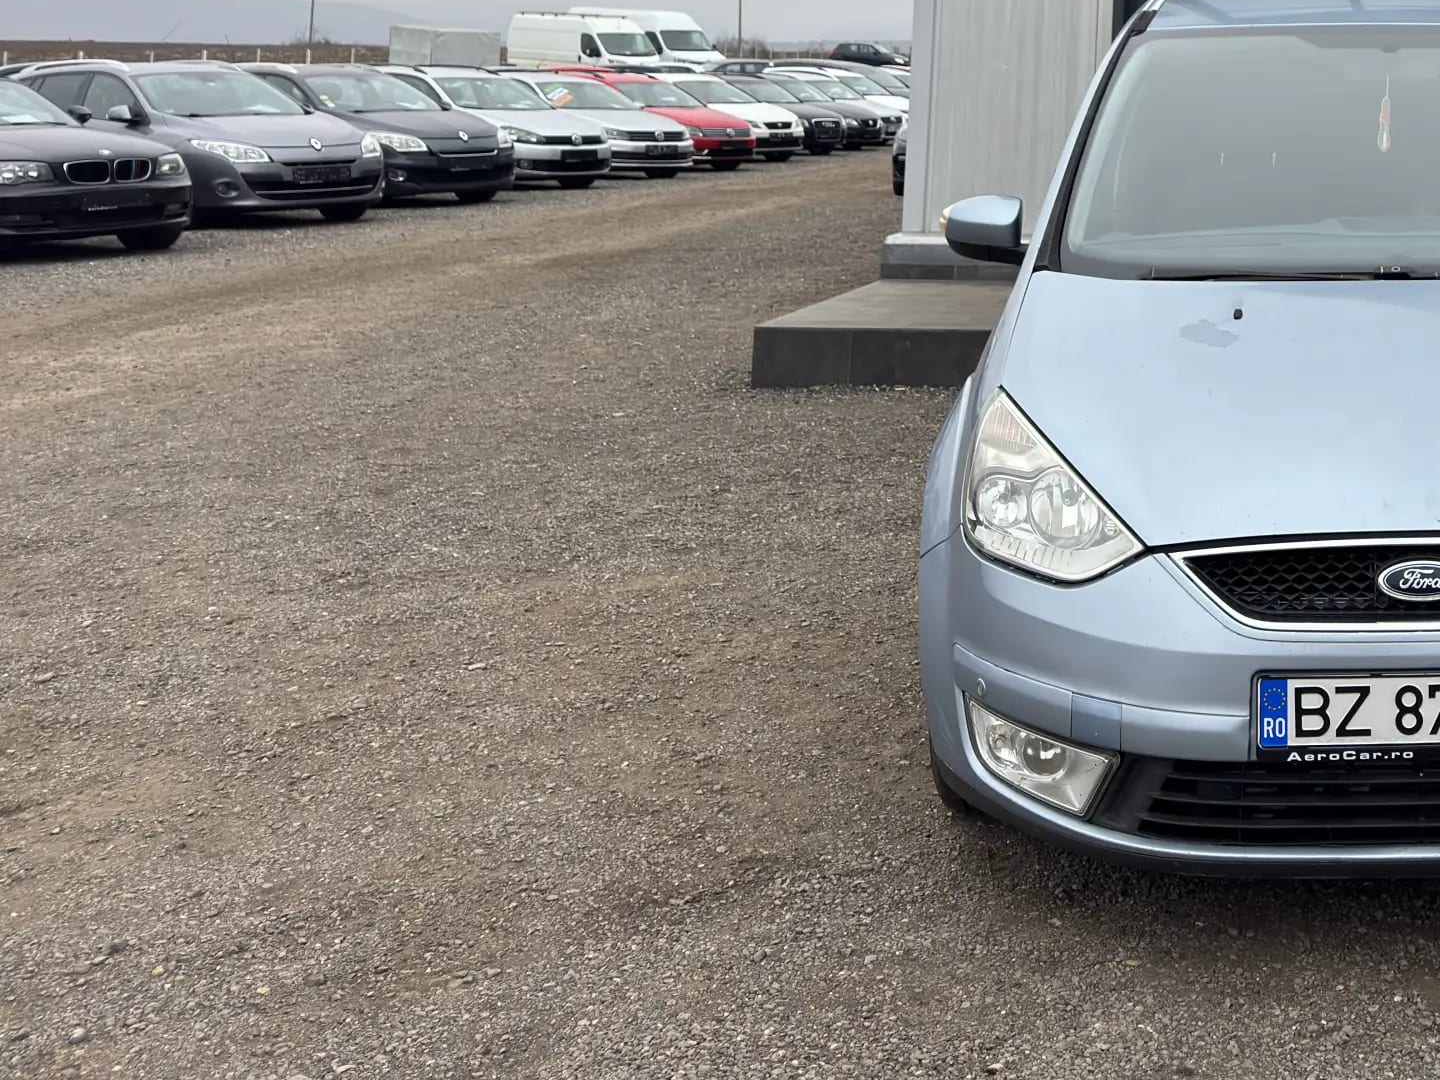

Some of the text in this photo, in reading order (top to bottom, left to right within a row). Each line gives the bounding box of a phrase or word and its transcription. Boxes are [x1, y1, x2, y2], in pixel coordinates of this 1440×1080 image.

[1294, 685, 1372, 738] BZ
[1263, 717, 1286, 739] RO
[1286, 750, 1415, 763] AeroCar.ro
